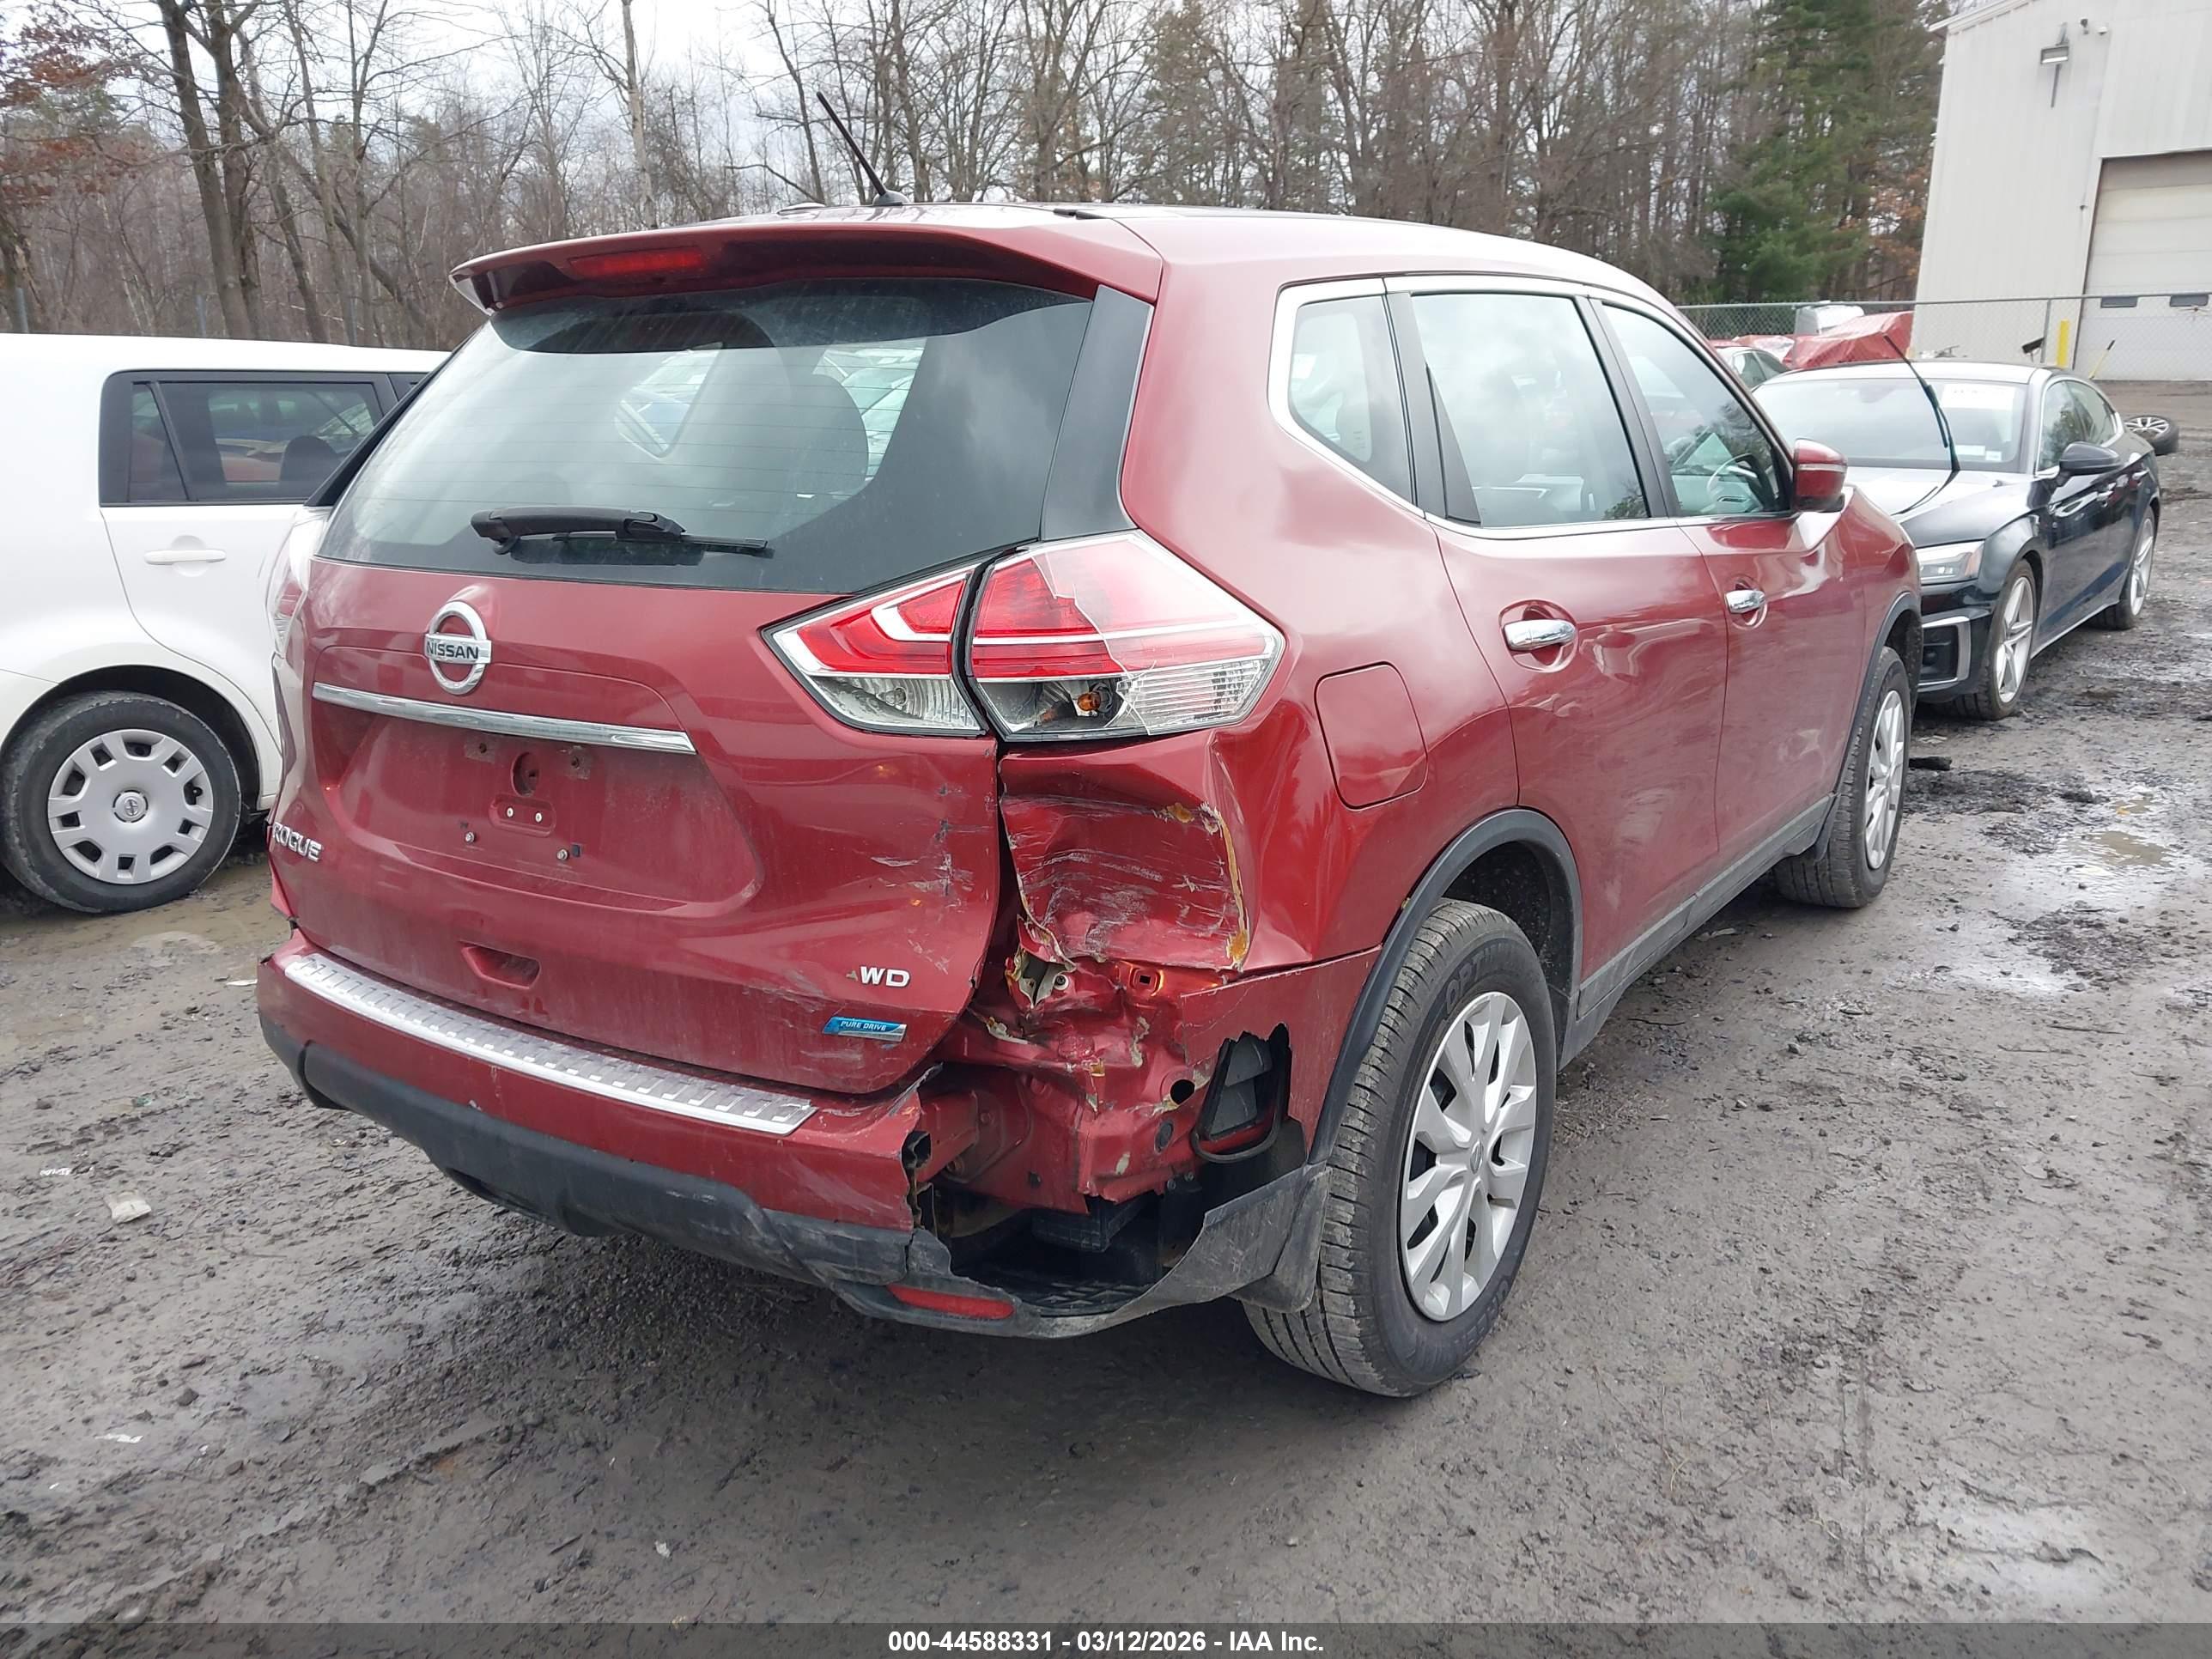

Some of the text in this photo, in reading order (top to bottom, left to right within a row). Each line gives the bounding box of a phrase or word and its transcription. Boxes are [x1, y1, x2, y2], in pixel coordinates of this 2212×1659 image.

[426, 641, 479, 659] NISSAN
[272, 821, 322, 862] ROGUE
[840, 1020, 887, 1031] PURE DRIVE
